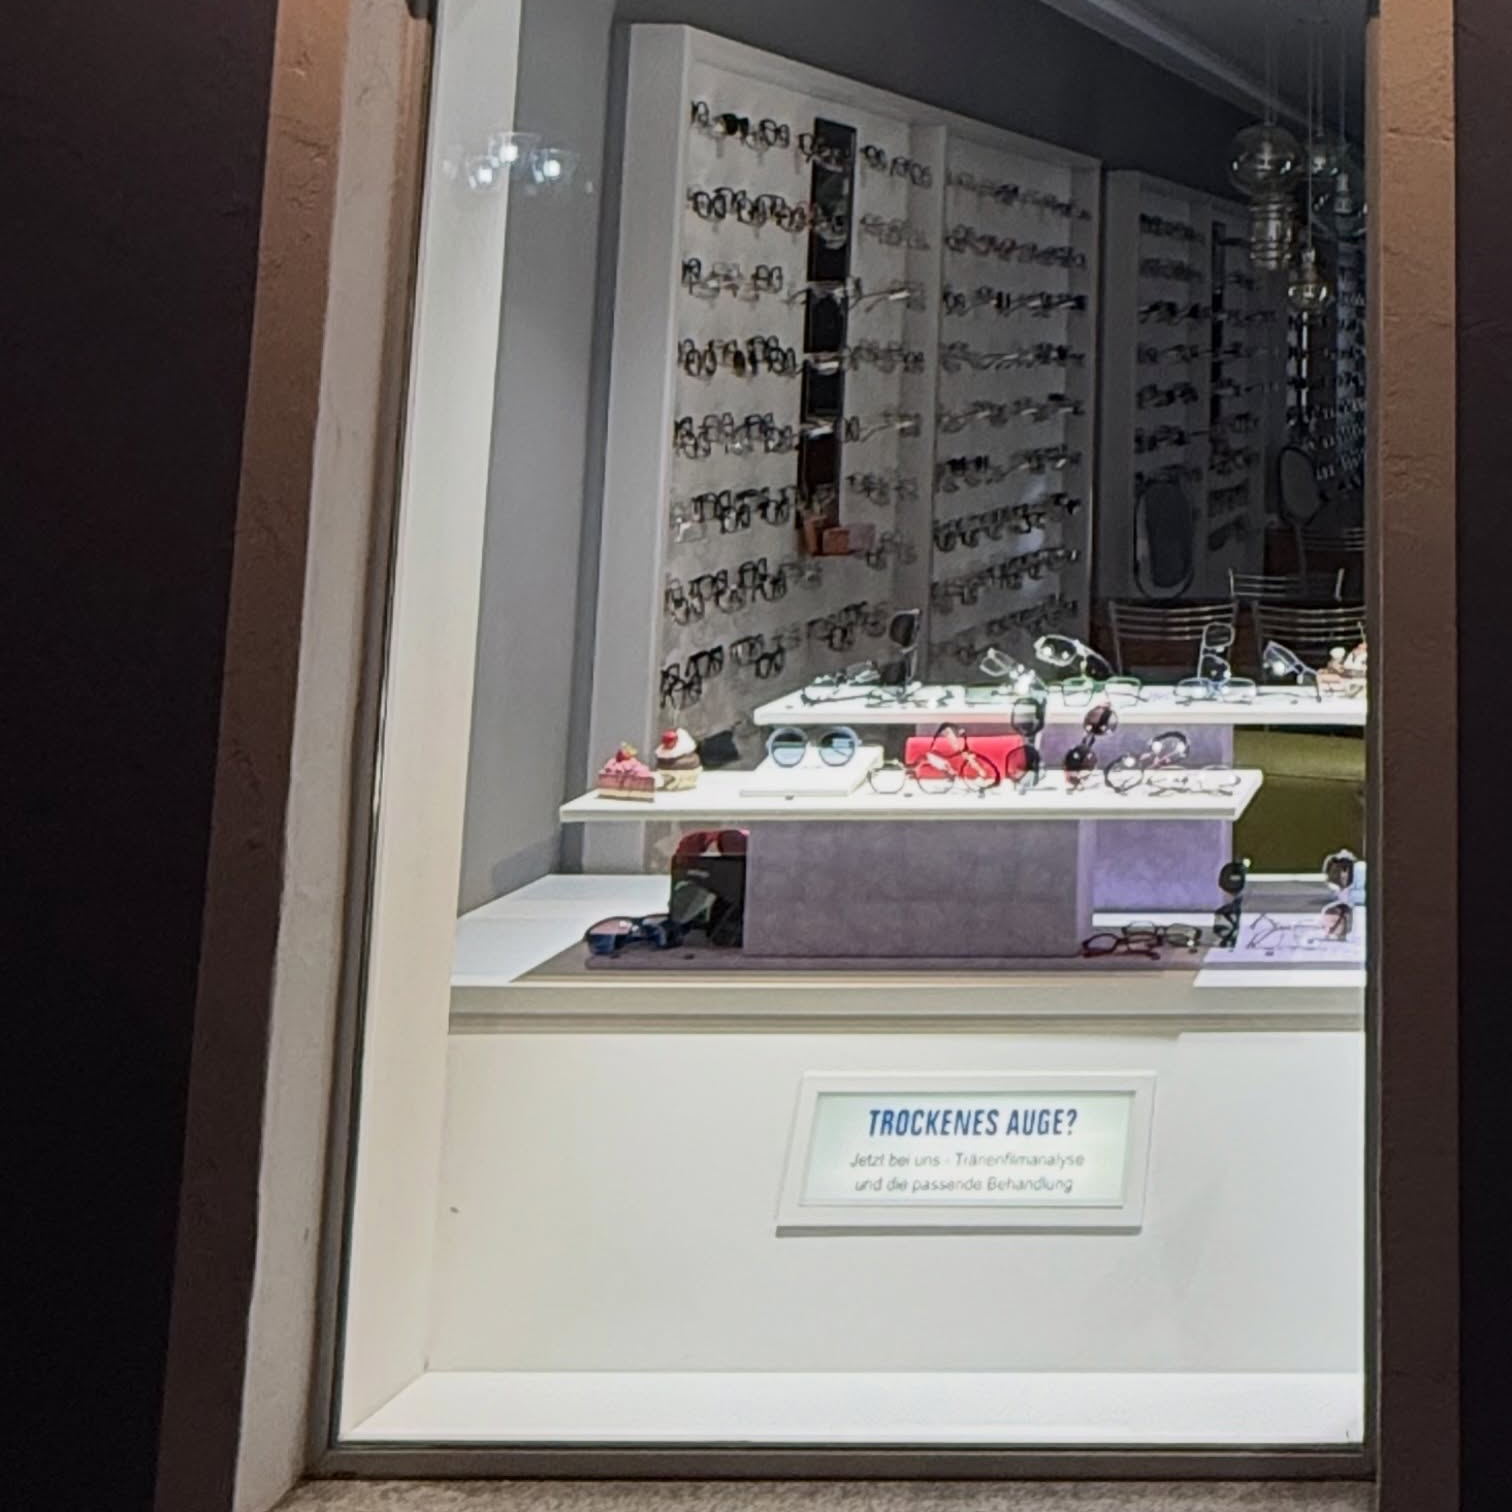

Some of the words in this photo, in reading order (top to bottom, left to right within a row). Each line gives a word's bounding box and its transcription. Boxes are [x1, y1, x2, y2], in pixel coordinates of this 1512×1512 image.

[868, 1108, 999, 1137] TROCKENES
[1005, 1108, 1078, 1136] AUGE?
[849, 1152, 885, 1168] Jetzt
[888, 1152, 910, 1168] bei
[914, 1154, 941, 1167] uns
[855, 1176, 883, 1192] und
[886, 1176, 908, 1191] die
[911, 1176, 982, 1194] passende
[986, 1176, 1074, 1194] Behandlung
